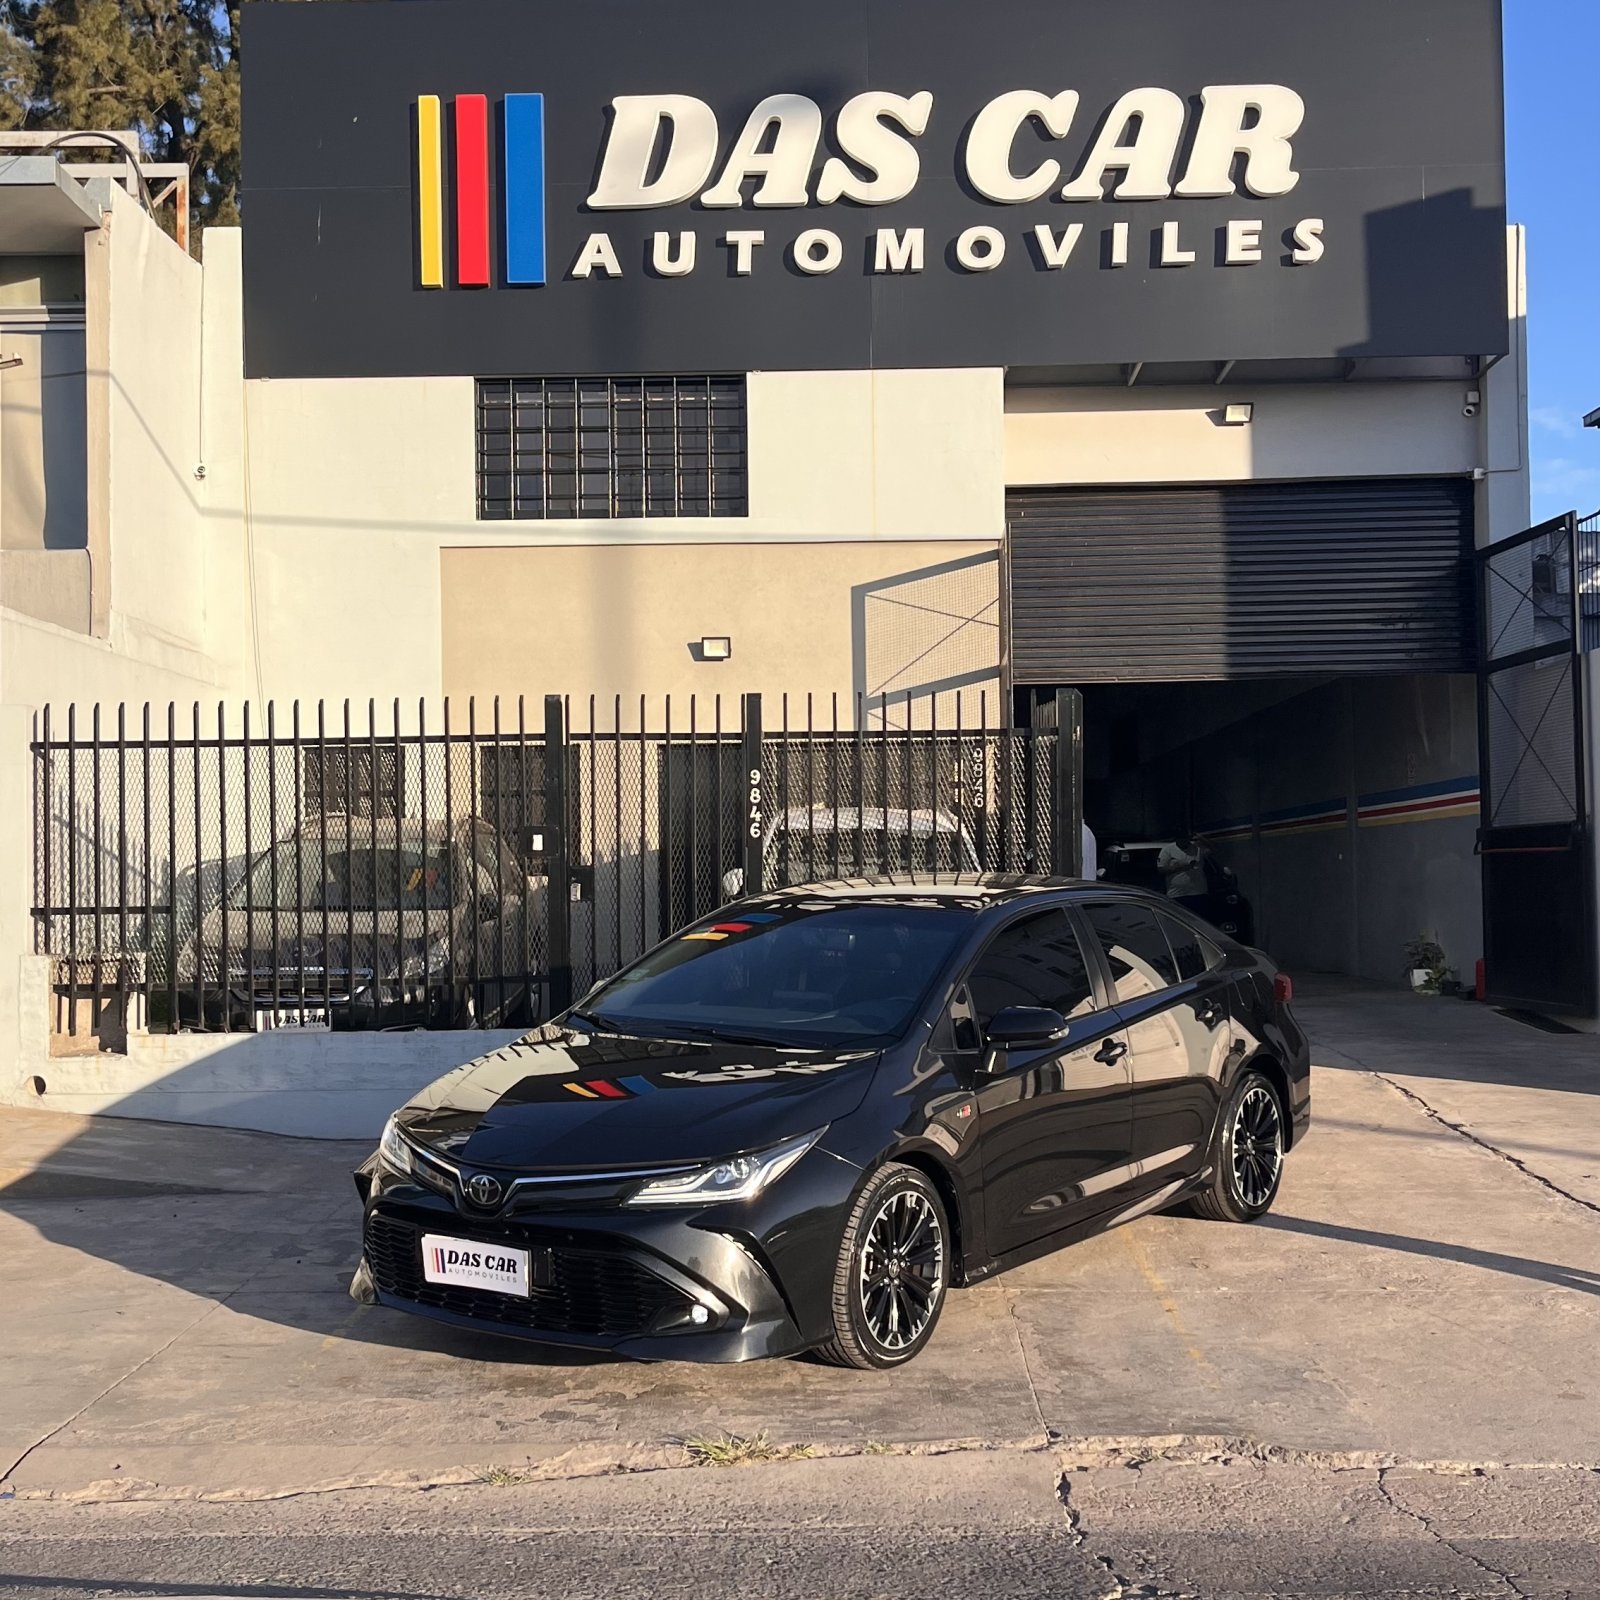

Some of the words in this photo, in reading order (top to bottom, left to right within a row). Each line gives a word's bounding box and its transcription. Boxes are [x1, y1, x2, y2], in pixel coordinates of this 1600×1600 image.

[586, 90, 934, 208] DAS
[965, 83, 1305, 203] CAR
[571, 218, 1325, 283] AUTOMOVILES
[749, 769, 763, 838] 9846
[447, 1250, 481, 1268] DAS
[484, 1255, 517, 1274] CAR
[448, 1268, 517, 1283] AUTOMOVILES
